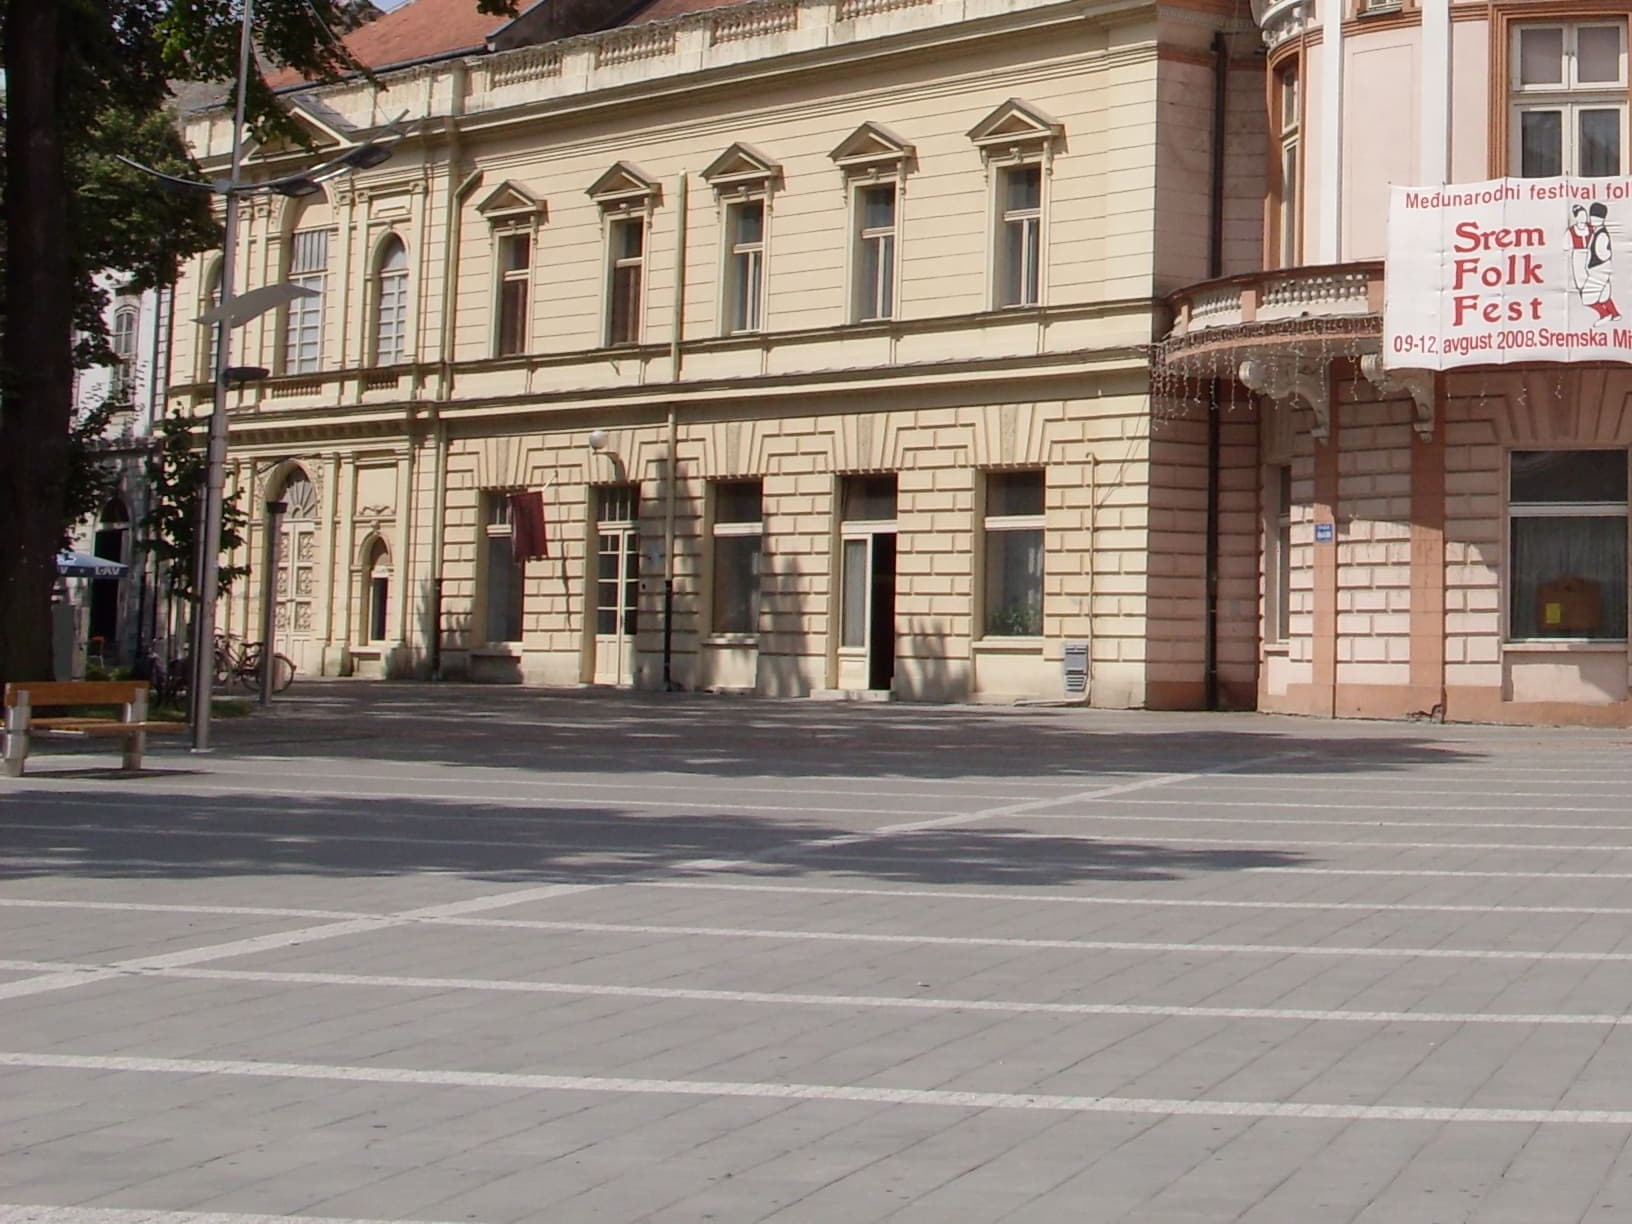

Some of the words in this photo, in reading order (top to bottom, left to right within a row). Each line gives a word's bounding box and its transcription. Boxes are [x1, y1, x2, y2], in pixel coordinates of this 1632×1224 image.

[1530, 182, 1596, 201] festival
[1454, 221, 1546, 253] Srem
[1452, 253, 1545, 290] Folk
[1452, 294, 1543, 327] Fest
[1443, 332, 1493, 356] avgust
[1538, 327, 1607, 348] Sremska
